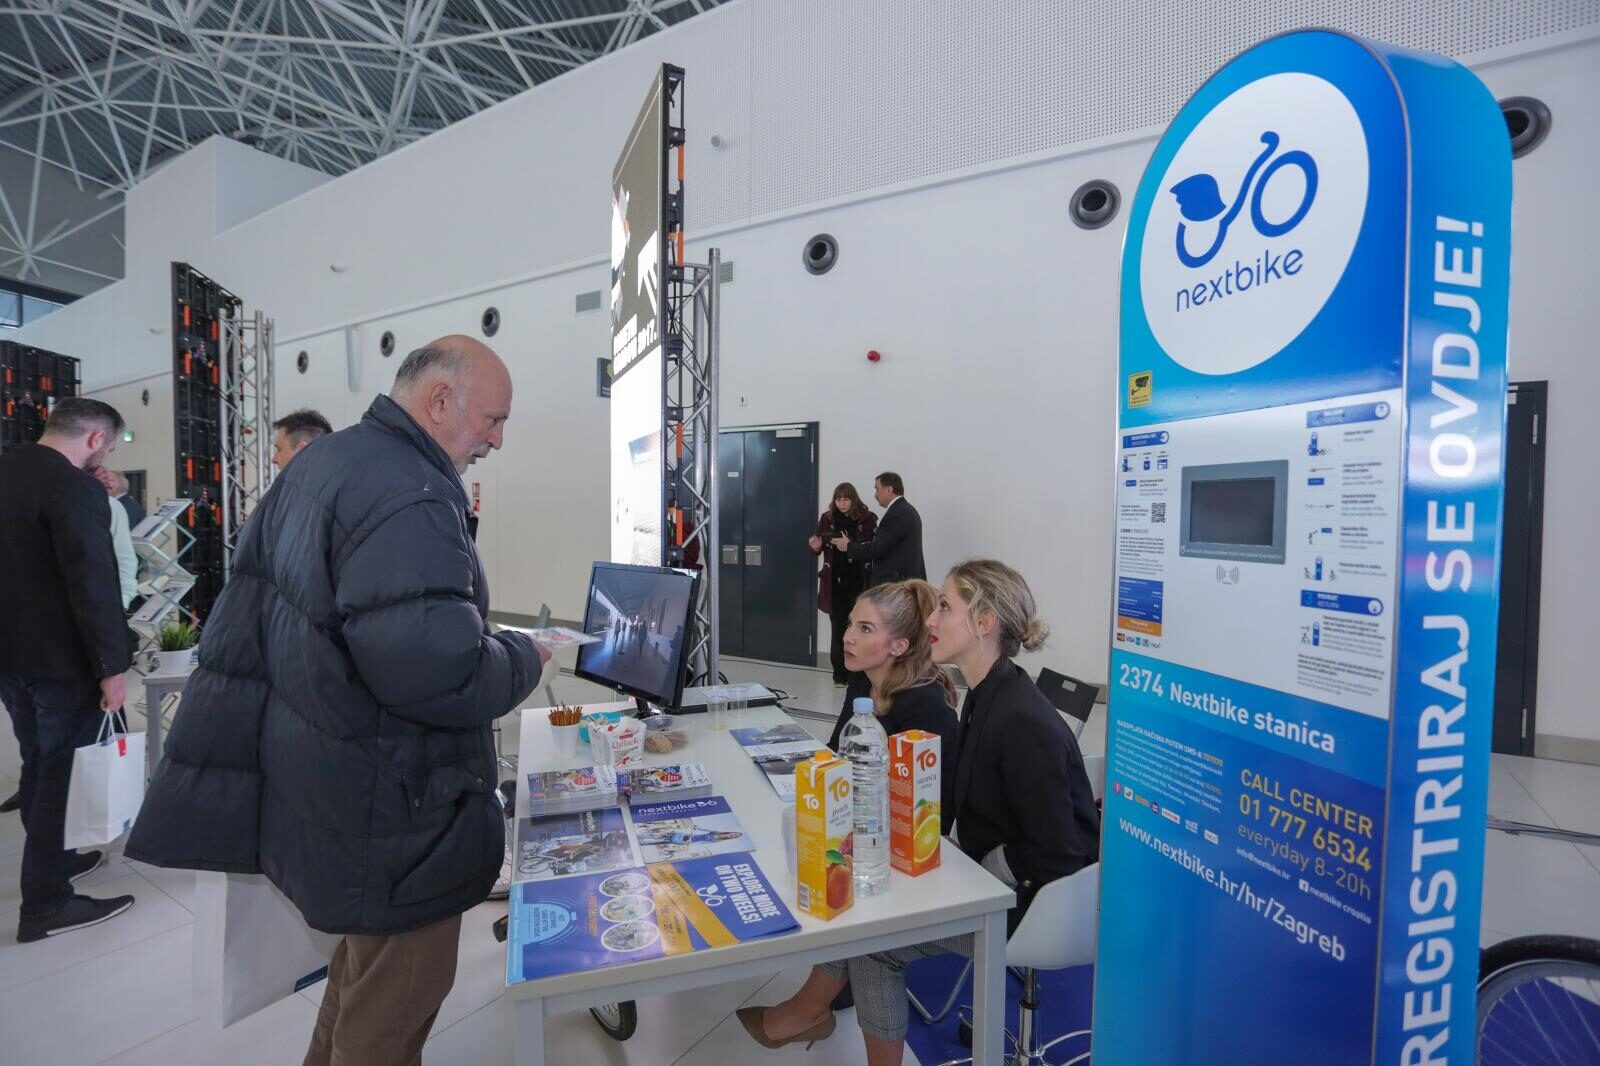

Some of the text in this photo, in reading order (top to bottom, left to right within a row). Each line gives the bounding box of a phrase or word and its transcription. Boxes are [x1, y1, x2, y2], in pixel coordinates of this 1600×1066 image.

[1176, 249, 1303, 312] nextbike
[1400, 215, 1484, 1066] REGISTRIRAJ SE OVDJE!
[1119, 663, 1335, 754] 2374 Nextbike stanica
[638, 803, 697, 814] nextbike
[1239, 794, 1261, 820] 01
[1268, 805, 1307, 839] 777
[1313, 828, 1372, 873] 6534
[1240, 768, 1285, 802] CALL
[1289, 788, 1373, 839] CENTER
[714, 864, 762, 924] ON TWO WEELS!
[733, 863, 781, 918] EXPLORE MORE
[1119, 817, 1346, 962] www.nextbike.hr/hr/Zagreb
[1236, 846, 1291, 880] info@nextbike.hr
[1237, 824, 1371, 900] everyday 8-20h
